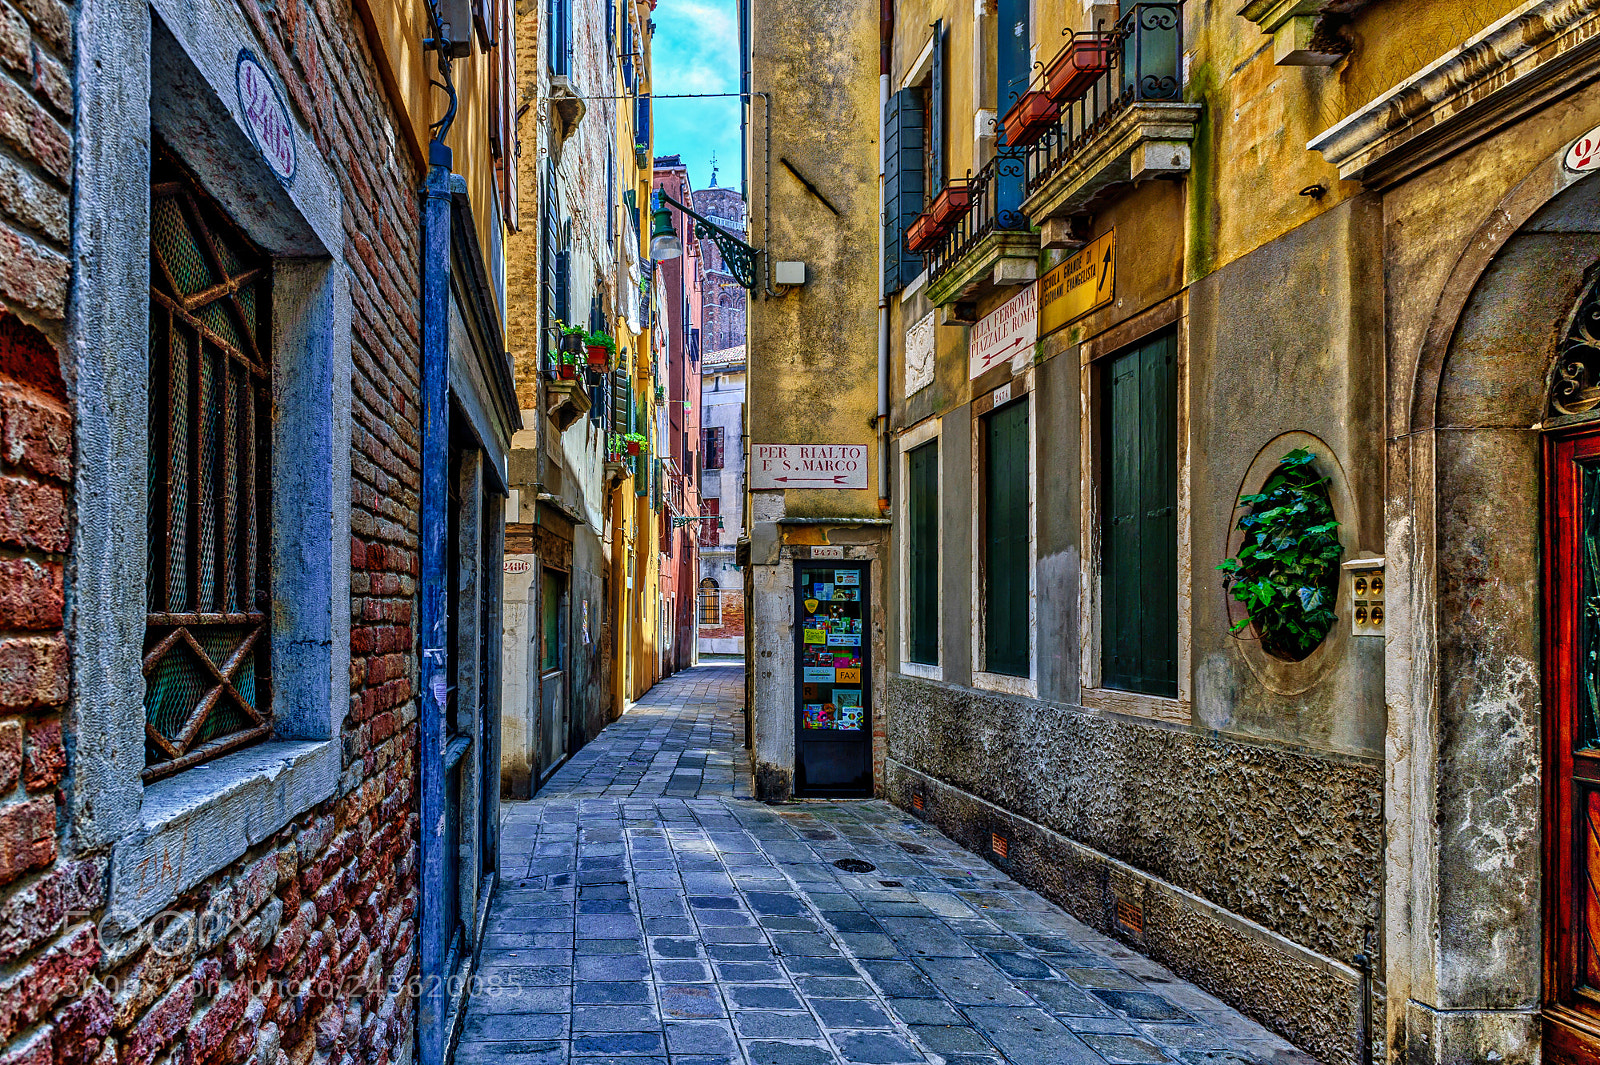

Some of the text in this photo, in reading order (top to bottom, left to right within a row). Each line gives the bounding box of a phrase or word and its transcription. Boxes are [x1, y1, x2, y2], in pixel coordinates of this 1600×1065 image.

[1063, 255, 1082, 279] GRANDE
[1086, 249, 1092, 265] DI
[1044, 284, 1064, 306] GIOVANNI
[1066, 263, 1096, 293] EVANGELISTA
[972, 287, 1036, 343] ALLA FERROVIA
[971, 306, 1036, 358] PIAZZALE ROMA
[759, 446, 861, 459] PER RIALTO
[763, 459, 772, 471] E
[503, 562, 528, 571] 2486
[840, 671, 856, 680] FAX
